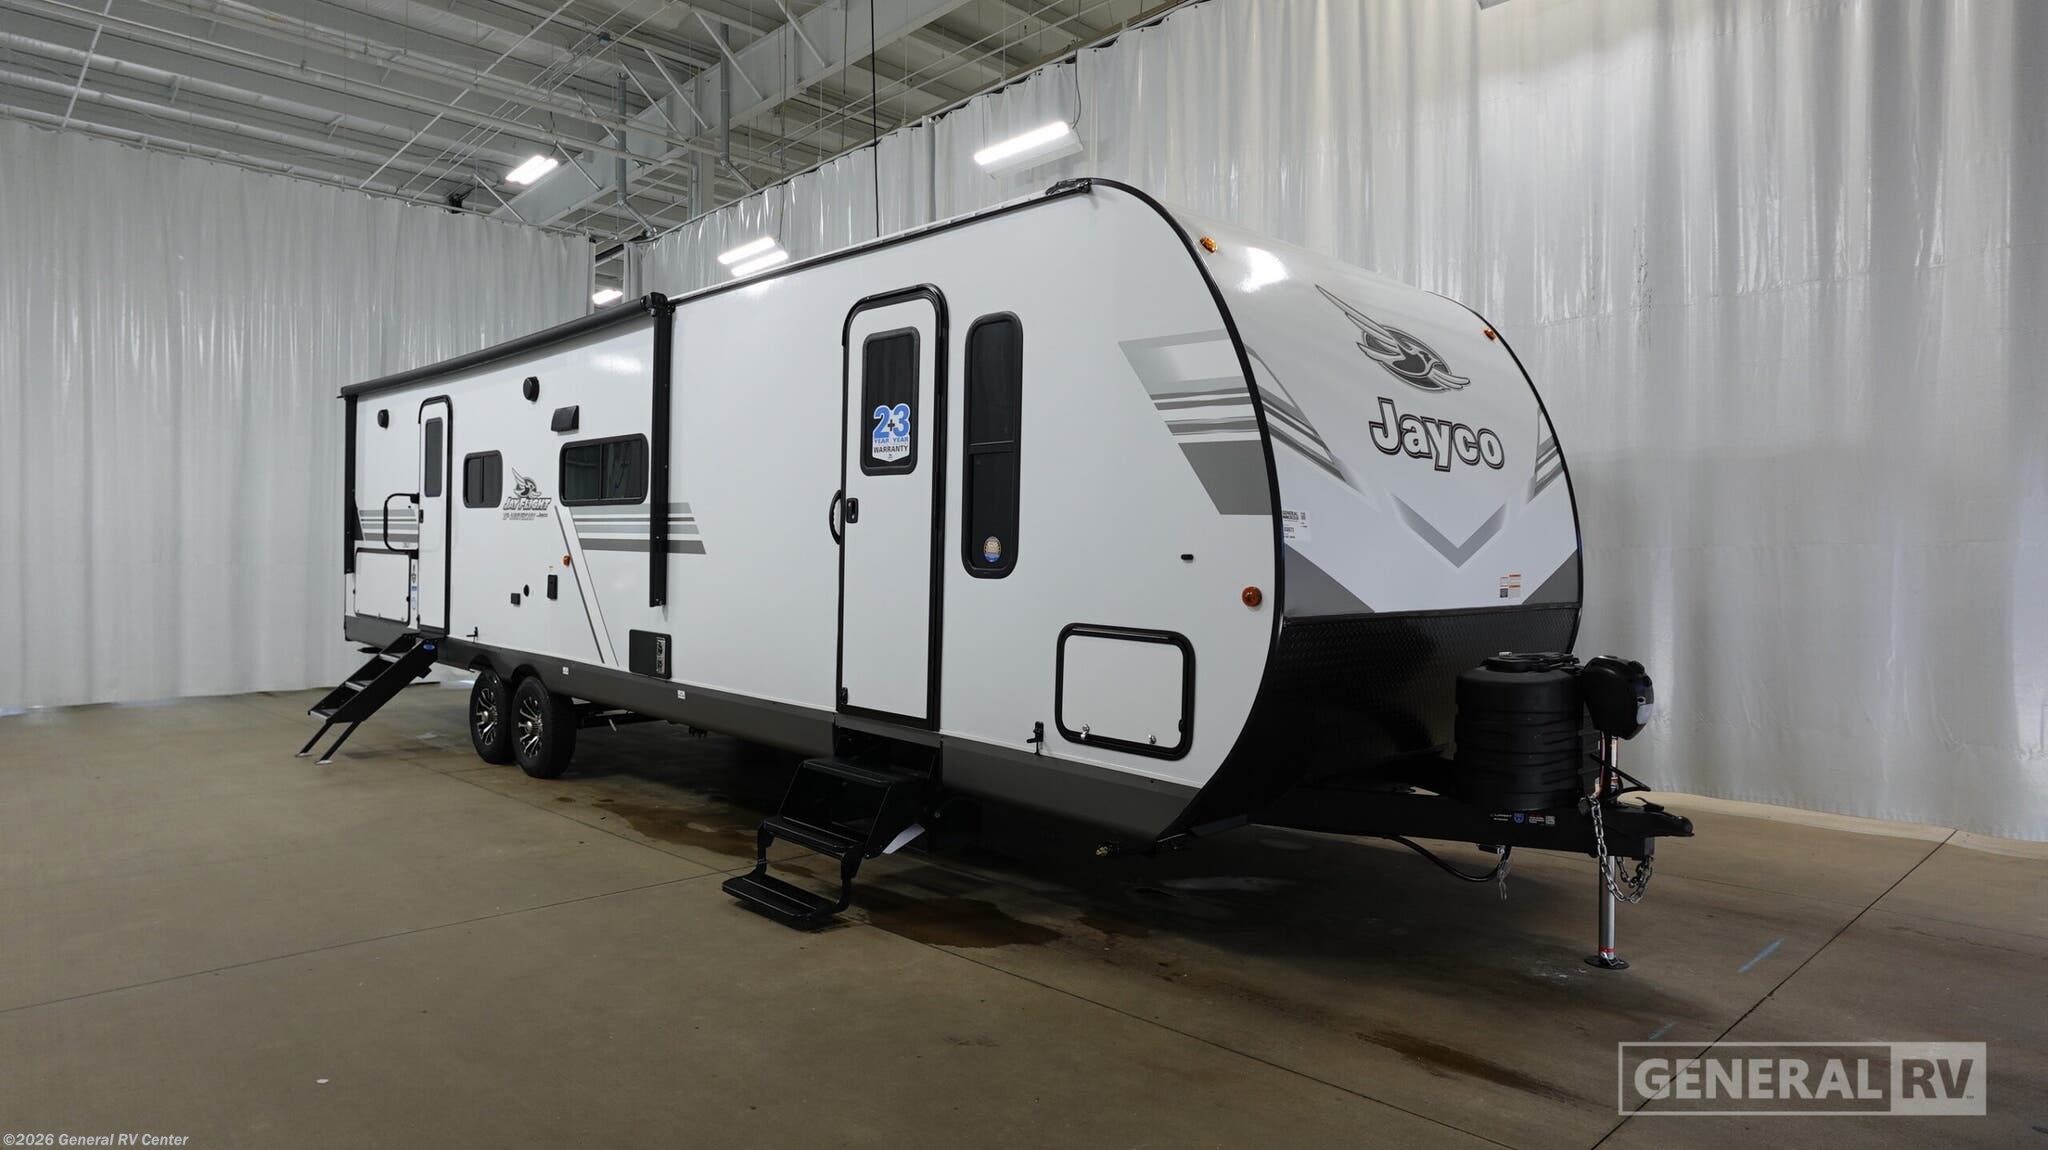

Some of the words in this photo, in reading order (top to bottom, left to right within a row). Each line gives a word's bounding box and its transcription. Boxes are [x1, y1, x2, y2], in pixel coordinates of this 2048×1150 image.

[1368, 396, 1505, 472] Jayco
[873, 445, 908, 453] WARRANTY
[503, 496, 521, 511] JAY
[518, 496, 552, 511] FLIGHT
